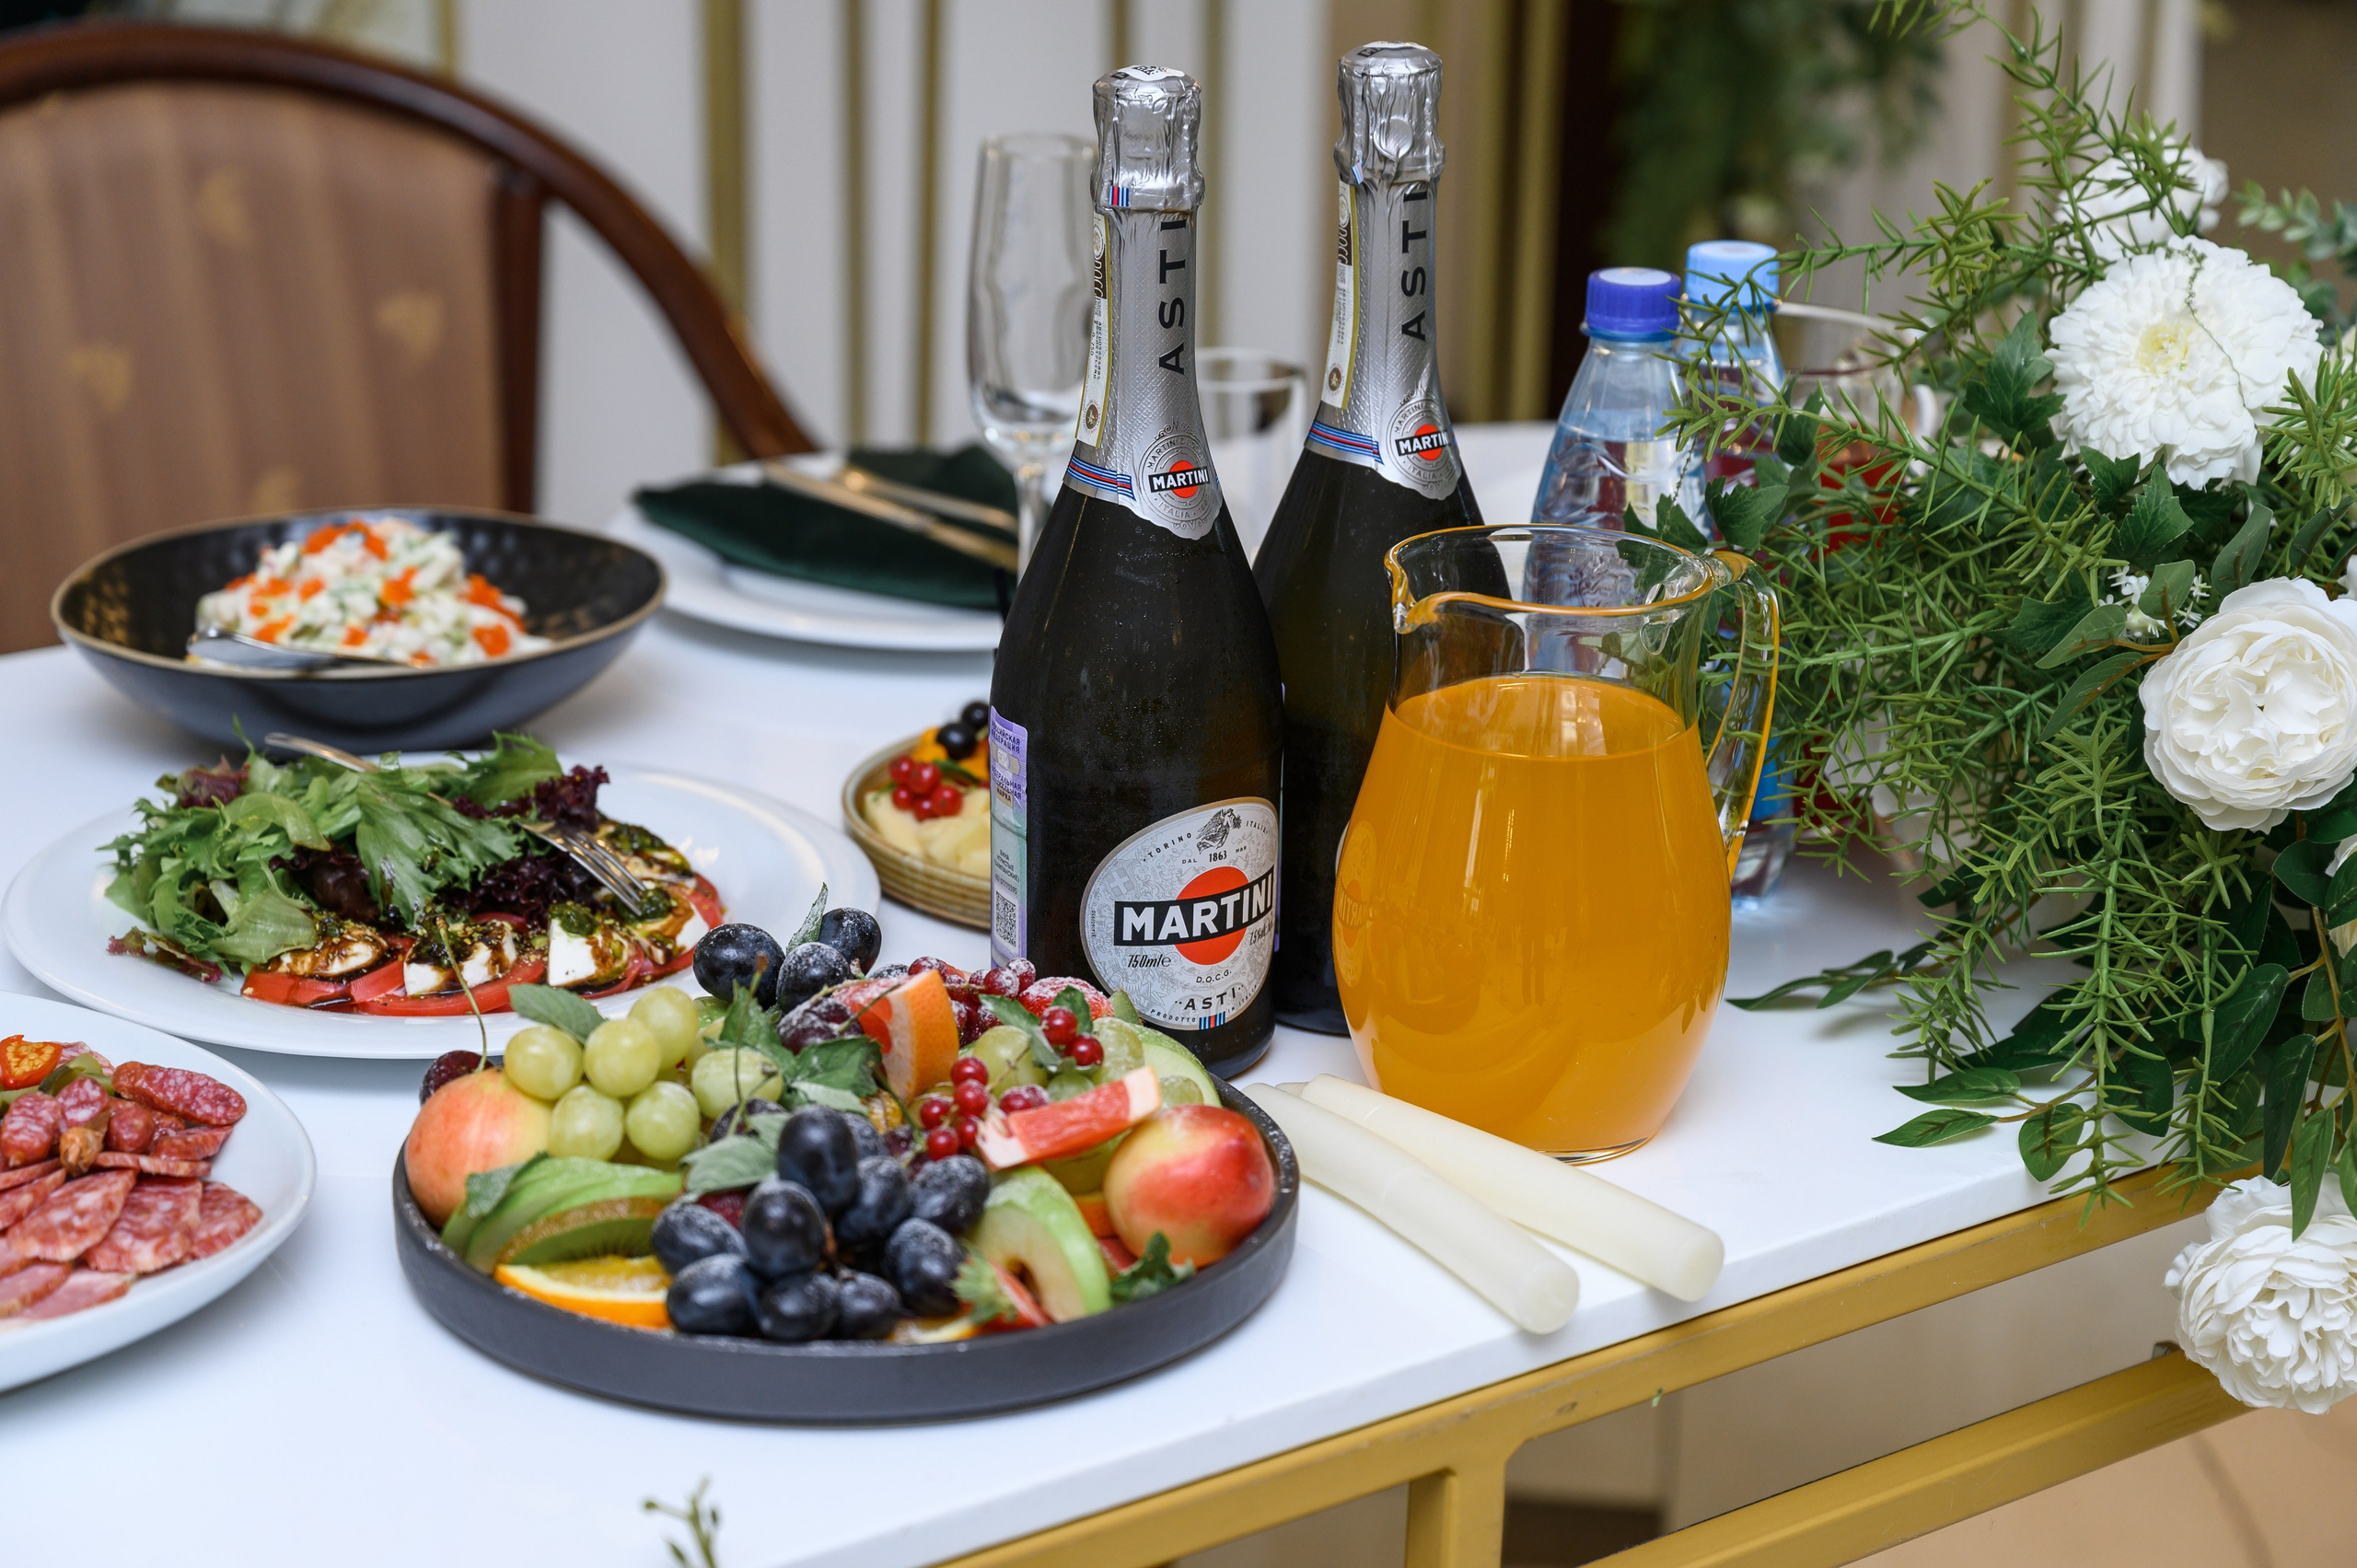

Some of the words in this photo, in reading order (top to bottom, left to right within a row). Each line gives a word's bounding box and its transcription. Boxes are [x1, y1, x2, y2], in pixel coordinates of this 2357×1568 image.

[1400, 191, 1428, 342] ASTI
[1158, 218, 1187, 376] ASTI
[1399, 431, 1451, 455] MARTIN
[1152, 469, 1209, 491] MARTINI
[1147, 832, 1192, 859] TORINO
[1208, 850, 1227, 863] 1863
[1122, 873, 1272, 941] MARTINI
[1196, 970, 1232, 983] D.O.C.G.
[1183, 987, 1237, 1011] ASTI
[1150, 1008, 1196, 1023] PRODOTTO
